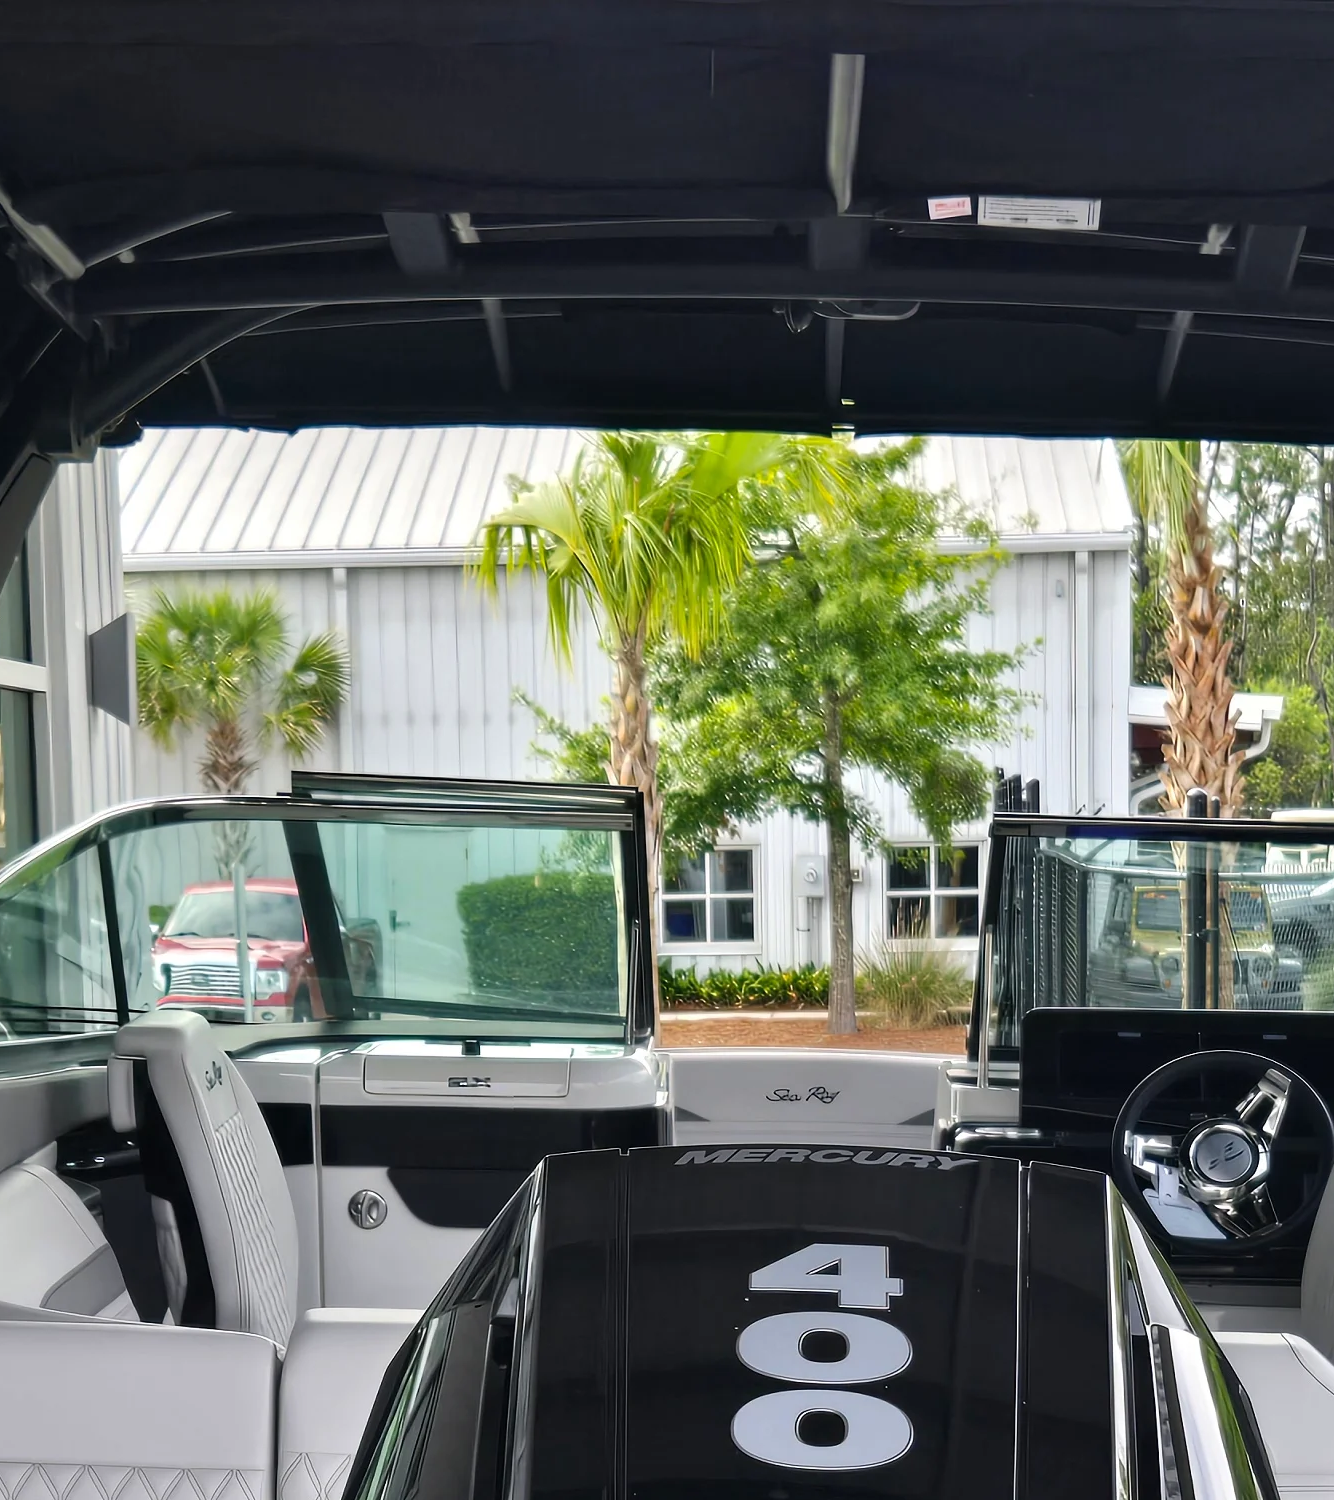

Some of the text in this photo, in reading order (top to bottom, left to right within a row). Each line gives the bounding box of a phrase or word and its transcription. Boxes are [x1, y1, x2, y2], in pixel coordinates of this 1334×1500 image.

[765, 1086, 842, 1104] Sea Ray
[673, 1147, 979, 1172] MERCURY
[730, 1242, 915, 1471] 400
